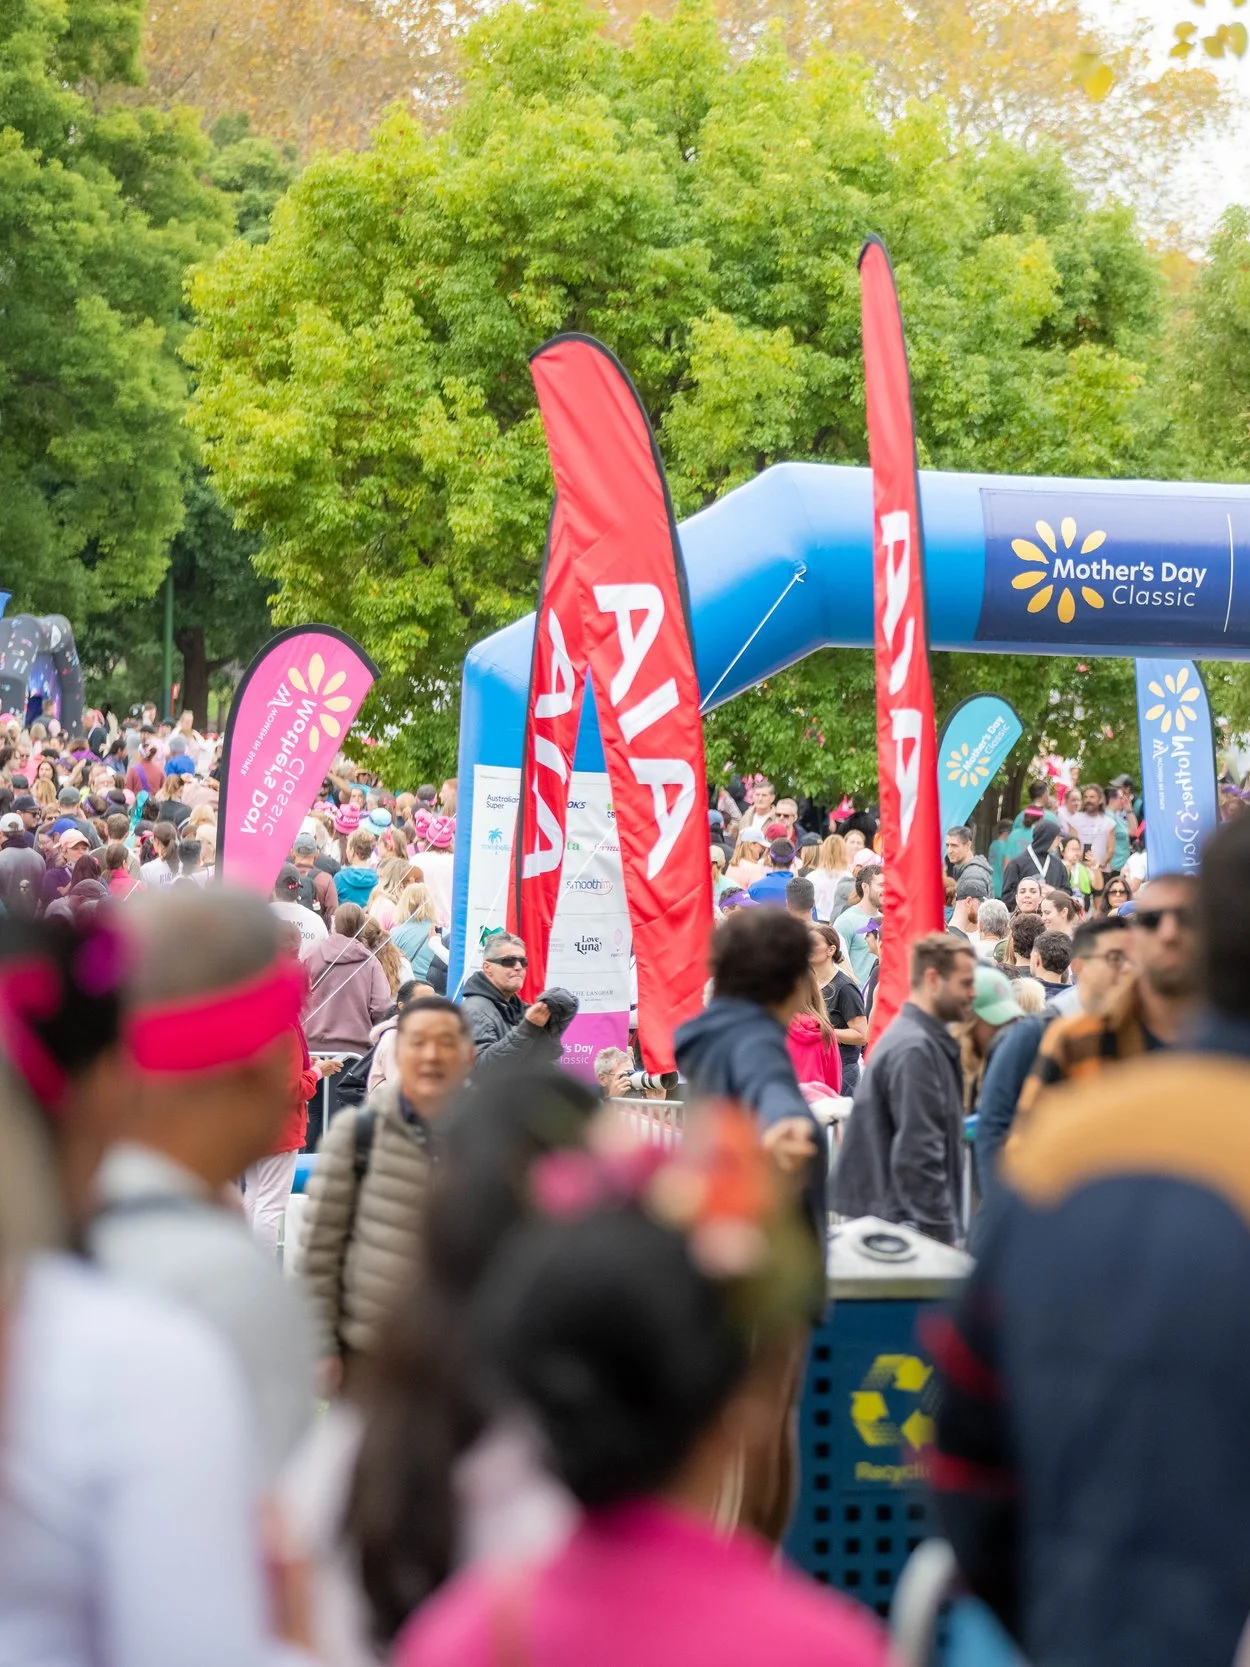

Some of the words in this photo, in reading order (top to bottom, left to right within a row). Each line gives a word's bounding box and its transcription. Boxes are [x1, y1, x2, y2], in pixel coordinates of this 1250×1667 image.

[1053, 558, 1154, 582] Mother's
[1161, 562, 1207, 588] Day
[1112, 585, 1196, 607] Classic
[986, 715, 1005, 735] Day
[593, 583, 696, 881] AIA
[486, 802, 505, 811] Super
[567, 801, 587, 809] OKS
[581, 935, 600, 943] Love
[574, 941, 602, 955] Luna
[574, 1043, 594, 1055] Day
[559, 1055, 590, 1066] lassic
